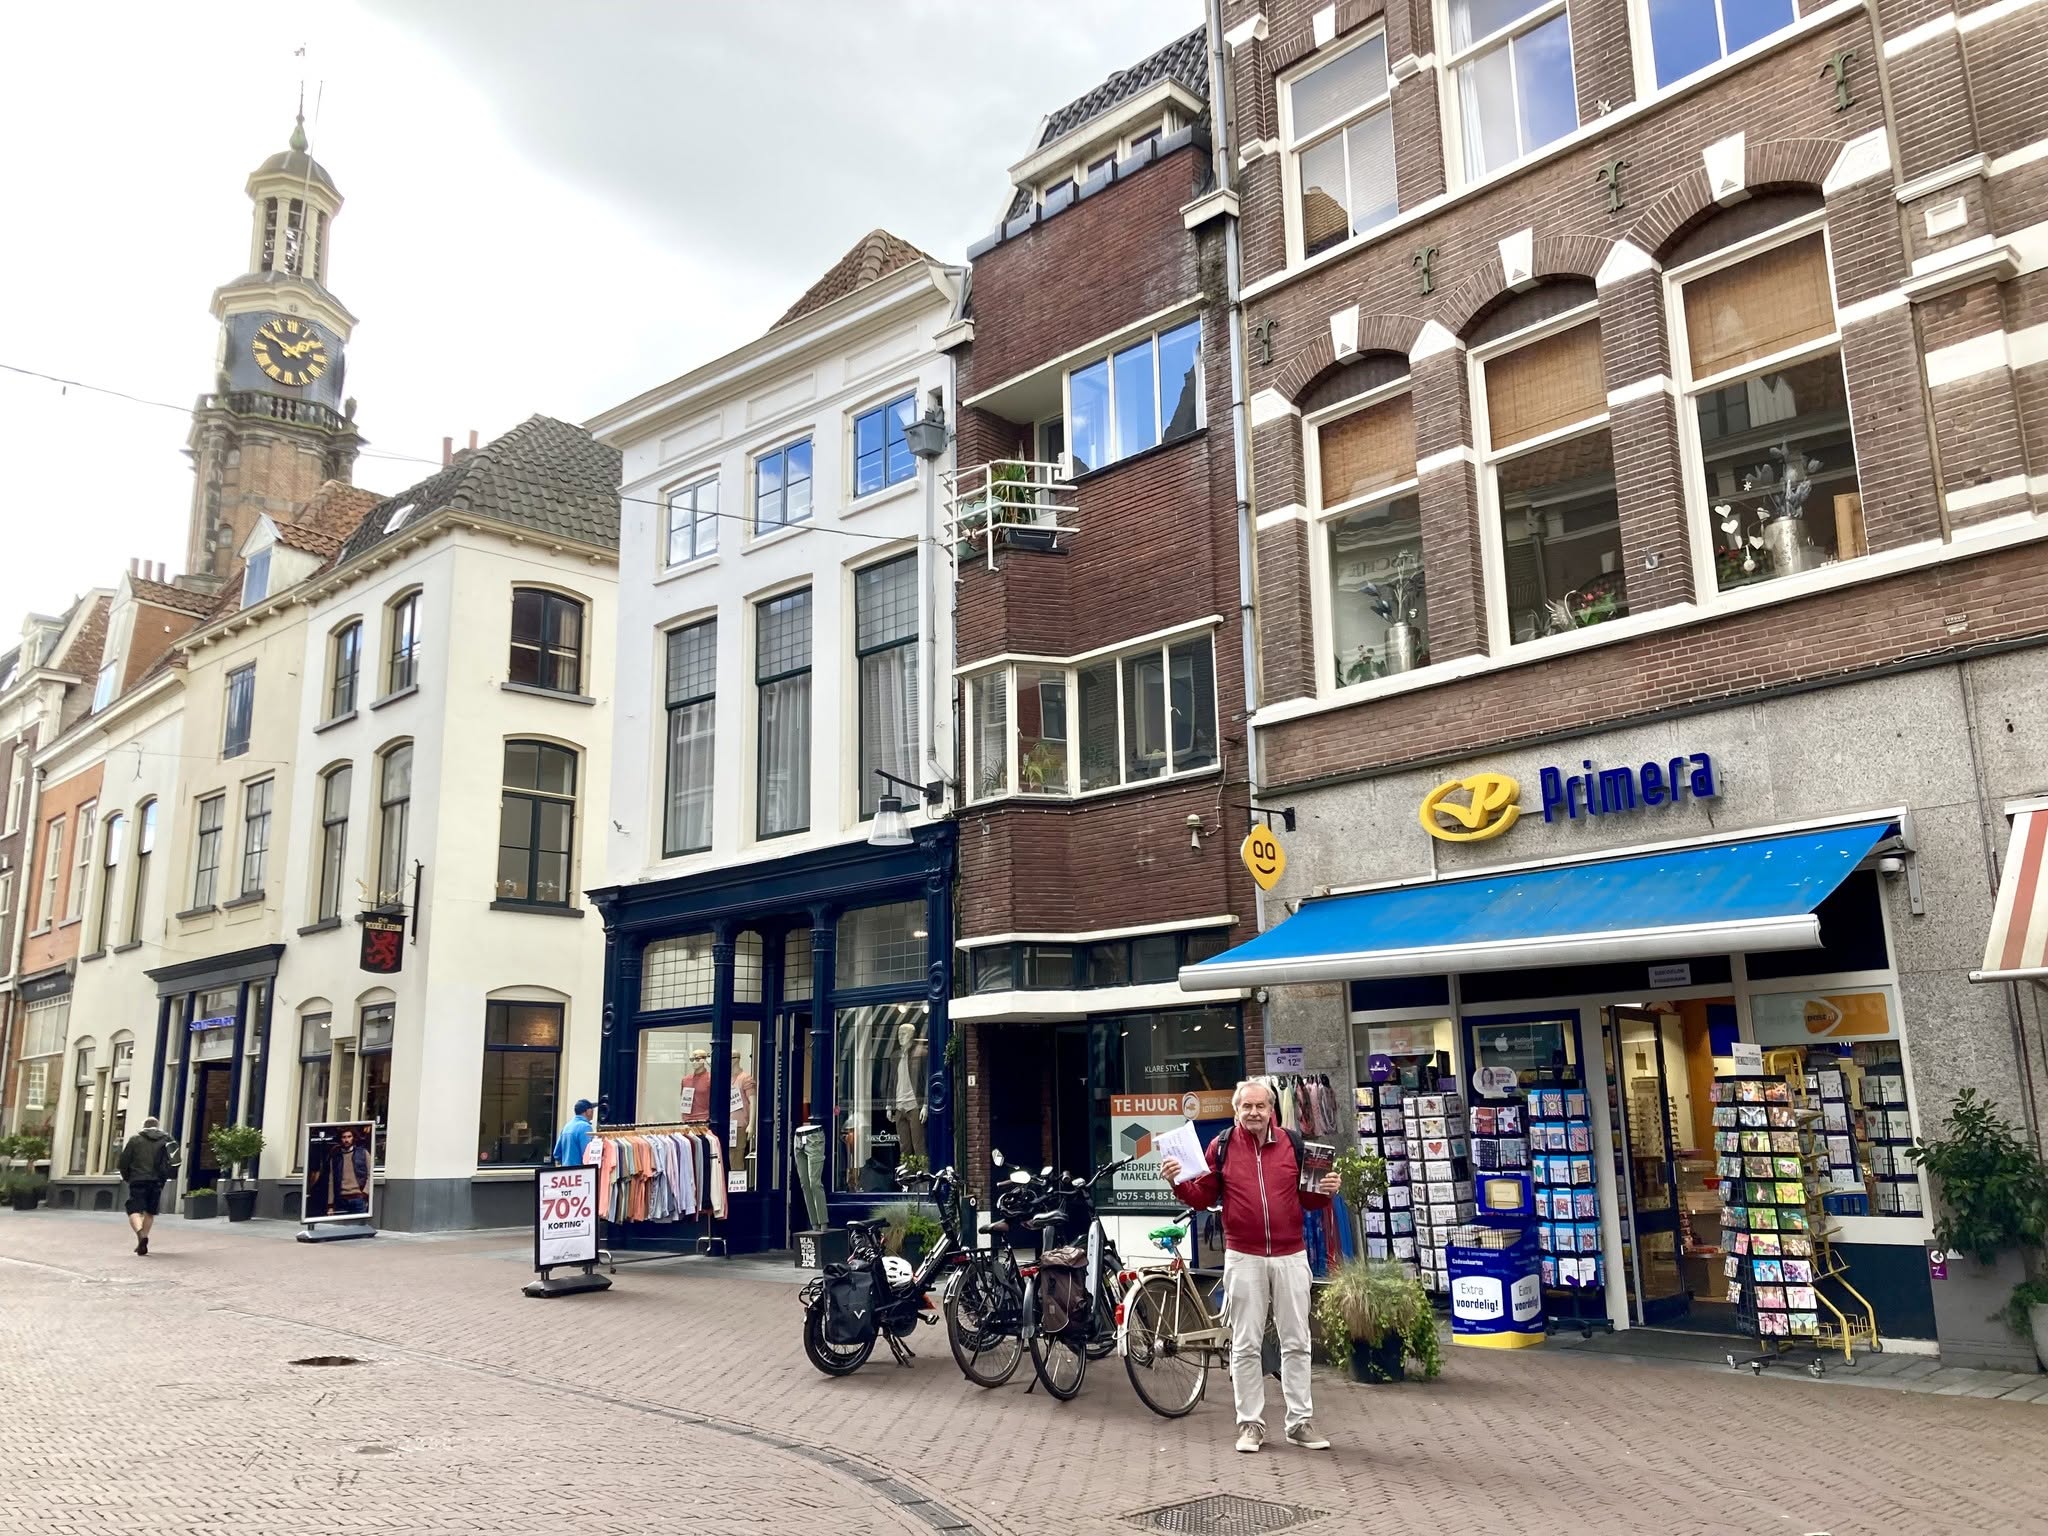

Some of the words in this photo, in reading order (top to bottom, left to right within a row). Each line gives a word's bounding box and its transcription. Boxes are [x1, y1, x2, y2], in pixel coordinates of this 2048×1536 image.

[1539, 752, 1717, 823] Primera
[1145, 1065, 1165, 1073] KLARE
[1114, 1099, 1131, 1112] TE
[1135, 1098, 1178, 1112] HUUR
[551, 1175, 582, 1188] SALE
[1121, 1172, 1164, 1181] MAKELAA
[1117, 1192, 1139, 1200] 0575
[1145, 1192, 1156, 1200] 84
[1157, 1192, 1169, 1200] 85
[542, 1196, 591, 1221] 70%
[801, 1253, 816, 1261] TIME
[1461, 1283, 1484, 1296] Extra
[1456, 1299, 1499, 1312] voordelig!
